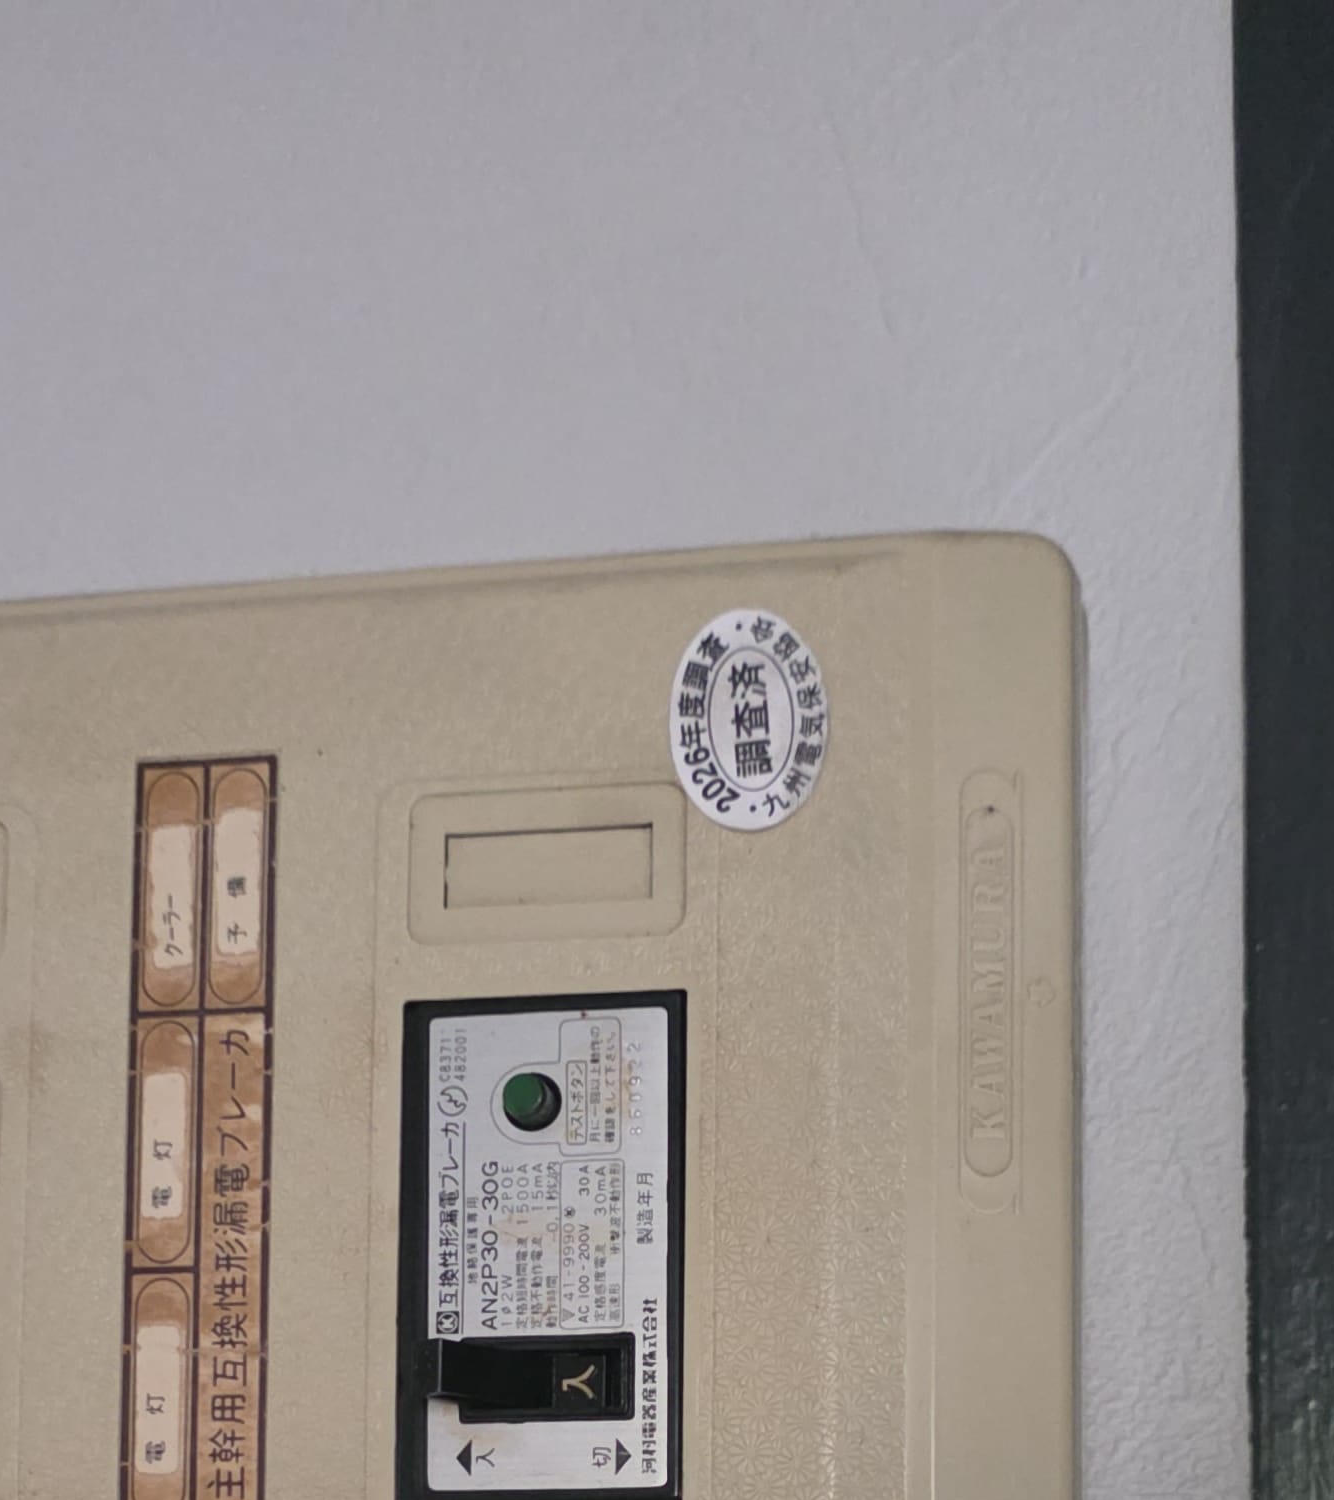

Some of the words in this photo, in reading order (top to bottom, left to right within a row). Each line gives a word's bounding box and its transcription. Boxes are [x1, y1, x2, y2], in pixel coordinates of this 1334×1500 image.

[677, 631, 740, 813] 2026年度調査
[727, 662, 773, 778] 調査済
[750, 616, 825, 817] 九州電気保安協会
[161, 892, 184, 958] クーラー
[970, 843, 1007, 1140] KAWAMURA
[570, 1063, 584, 1141] テストボタン
[438, 1122, 460, 1307] 互換性形漏電ブレーカ
[516, 1164, 528, 1225] 1500A
[531, 1163, 543, 1211] 15mA
[579, 1165, 590, 1196] 30A
[594, 1166, 606, 1216] 30mA
[636, 1172, 654, 1244] 製造年月
[204, 1027, 252, 1500] 主幹用互換性形漏電ブレーカ
[481, 1161, 498, 1330] AN2P30-30G
[579, 1305, 590, 1323] AC
[561, 1365, 596, 1399] 入
[476, 1447, 495, 1468] 入
[592, 1446, 612, 1468] 切
